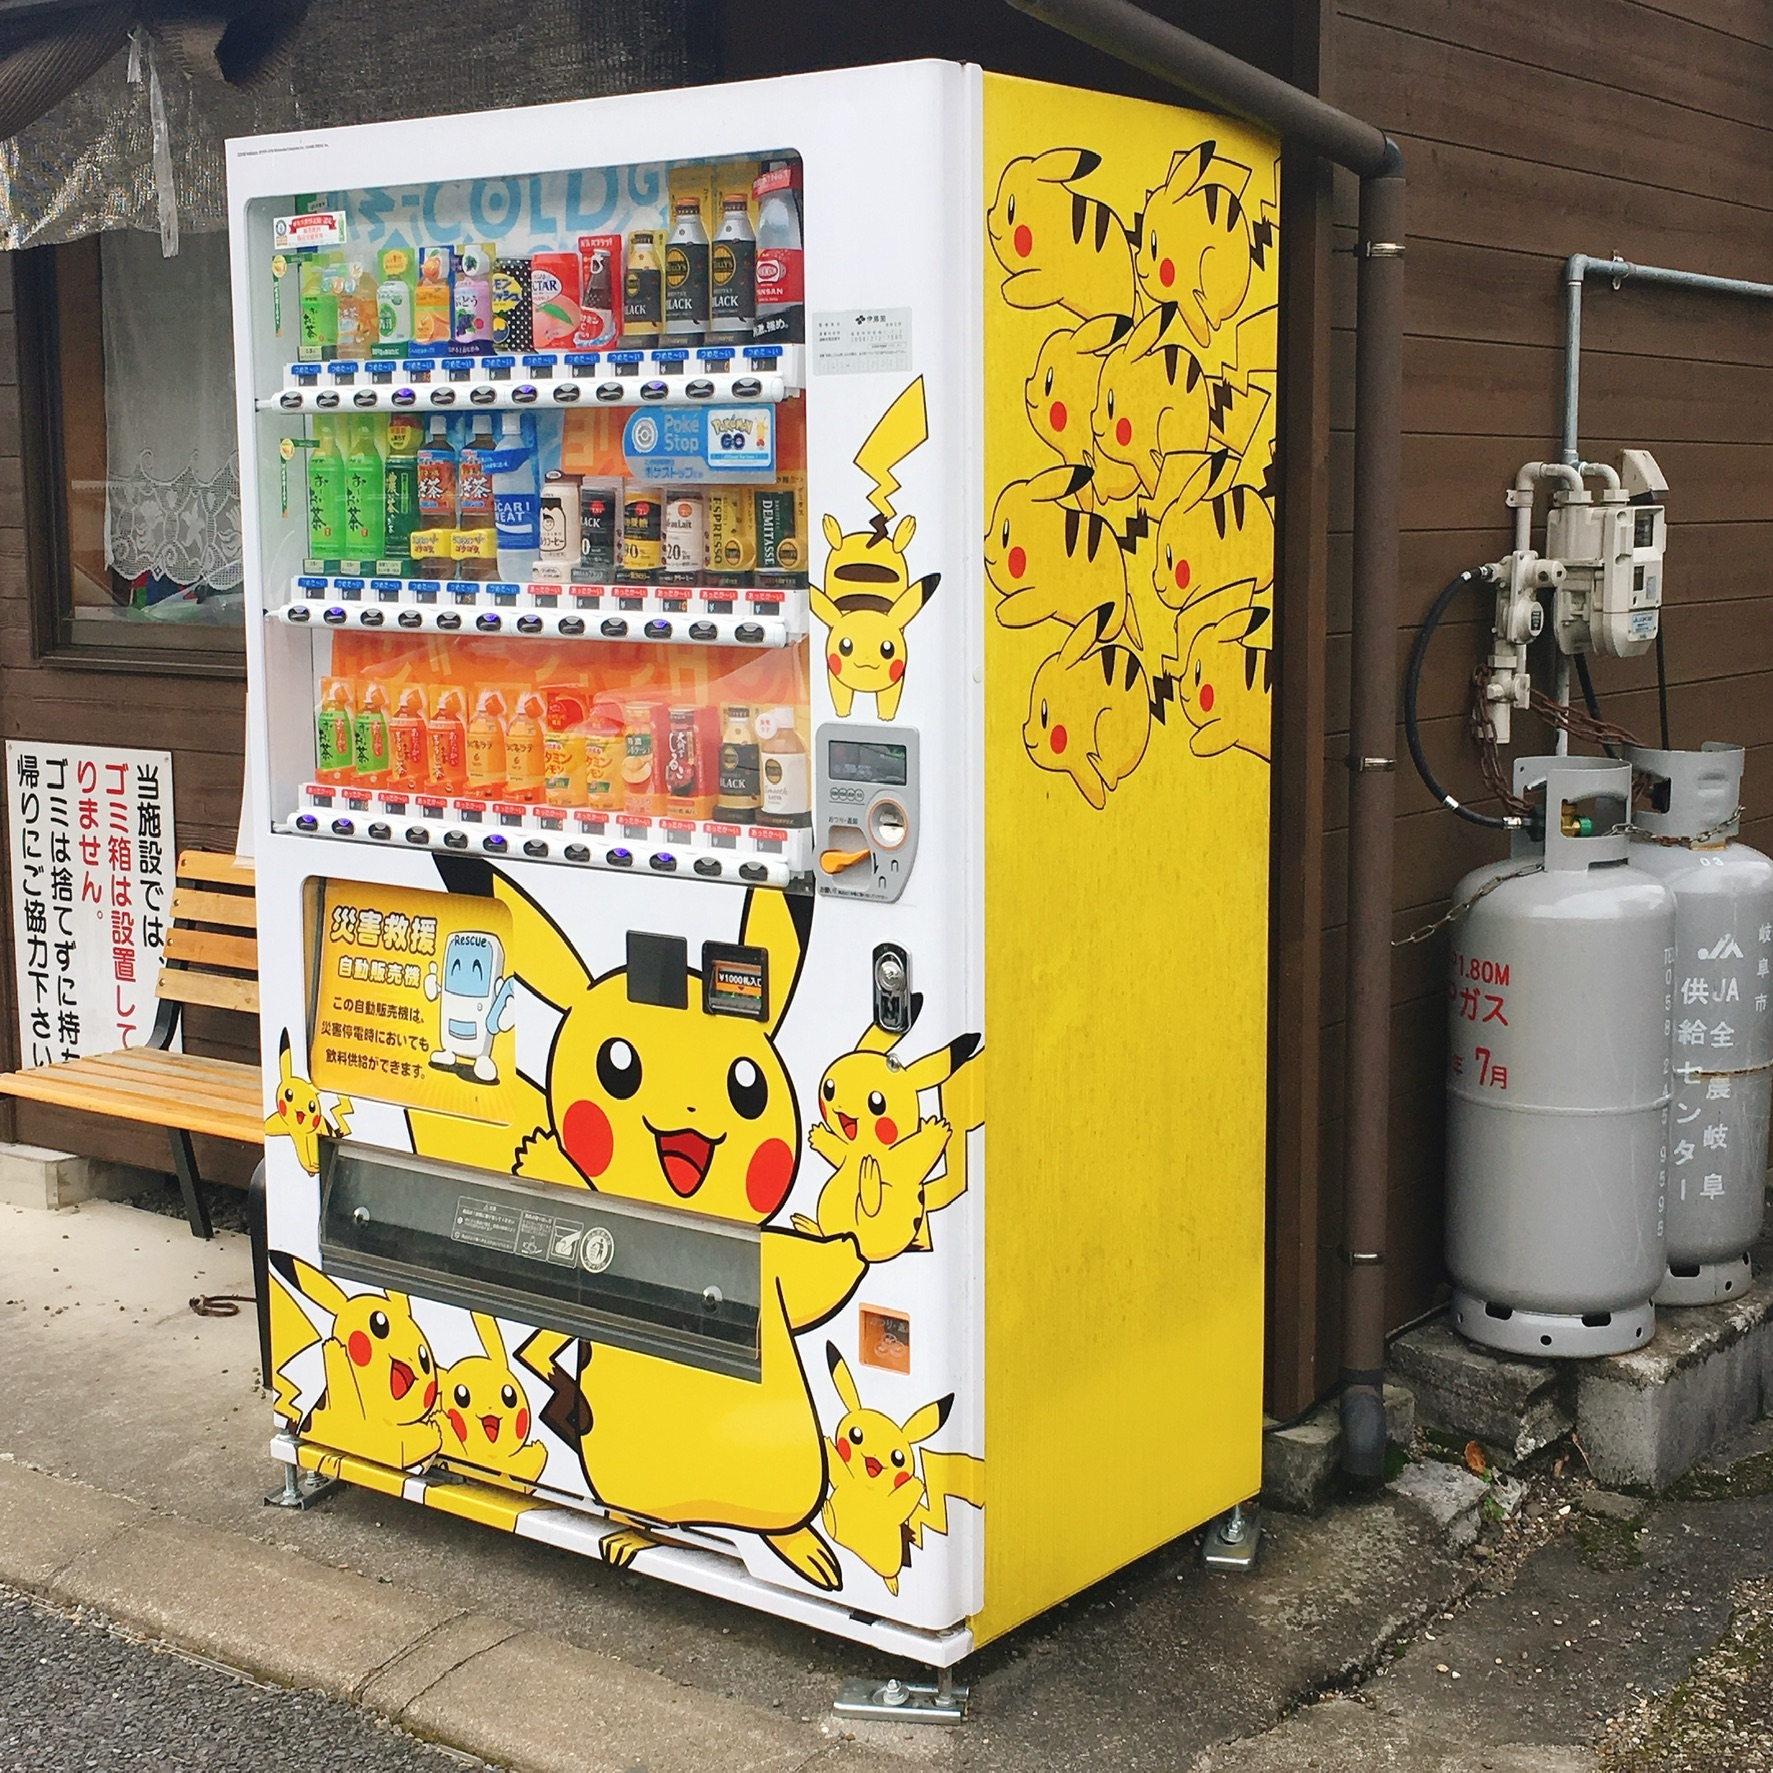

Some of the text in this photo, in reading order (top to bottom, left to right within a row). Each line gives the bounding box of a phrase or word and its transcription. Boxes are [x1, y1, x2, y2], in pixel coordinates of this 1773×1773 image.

[664, 413, 699, 434] Poké
[664, 433, 699, 453] Stop
[720, 433, 745, 450] GO
[763, 500, 775, 566] DEMITASSE
[546, 752, 573, 765] タミン
[586, 756, 613, 769] タミン
[77, 760, 104, 920] りません。
[137, 763, 166, 964] 当施設では、
[17, 754, 52, 1067] 帰りにご協力下さい
[105, 763, 137, 1049] ゴミ箱は設置して
[330, 905, 438, 956] 災害救援
[454, 934, 487, 948] Rescue
[338, 955, 421, 988] 自動販売機
[1755, 922, 1772, 1012] 岐阜市
[333, 996, 424, 1023] この自動販売機は、
[321, 1020, 430, 1051] 災害停電時においても
[326, 1048, 425, 1080] 飲料供給ができます。
